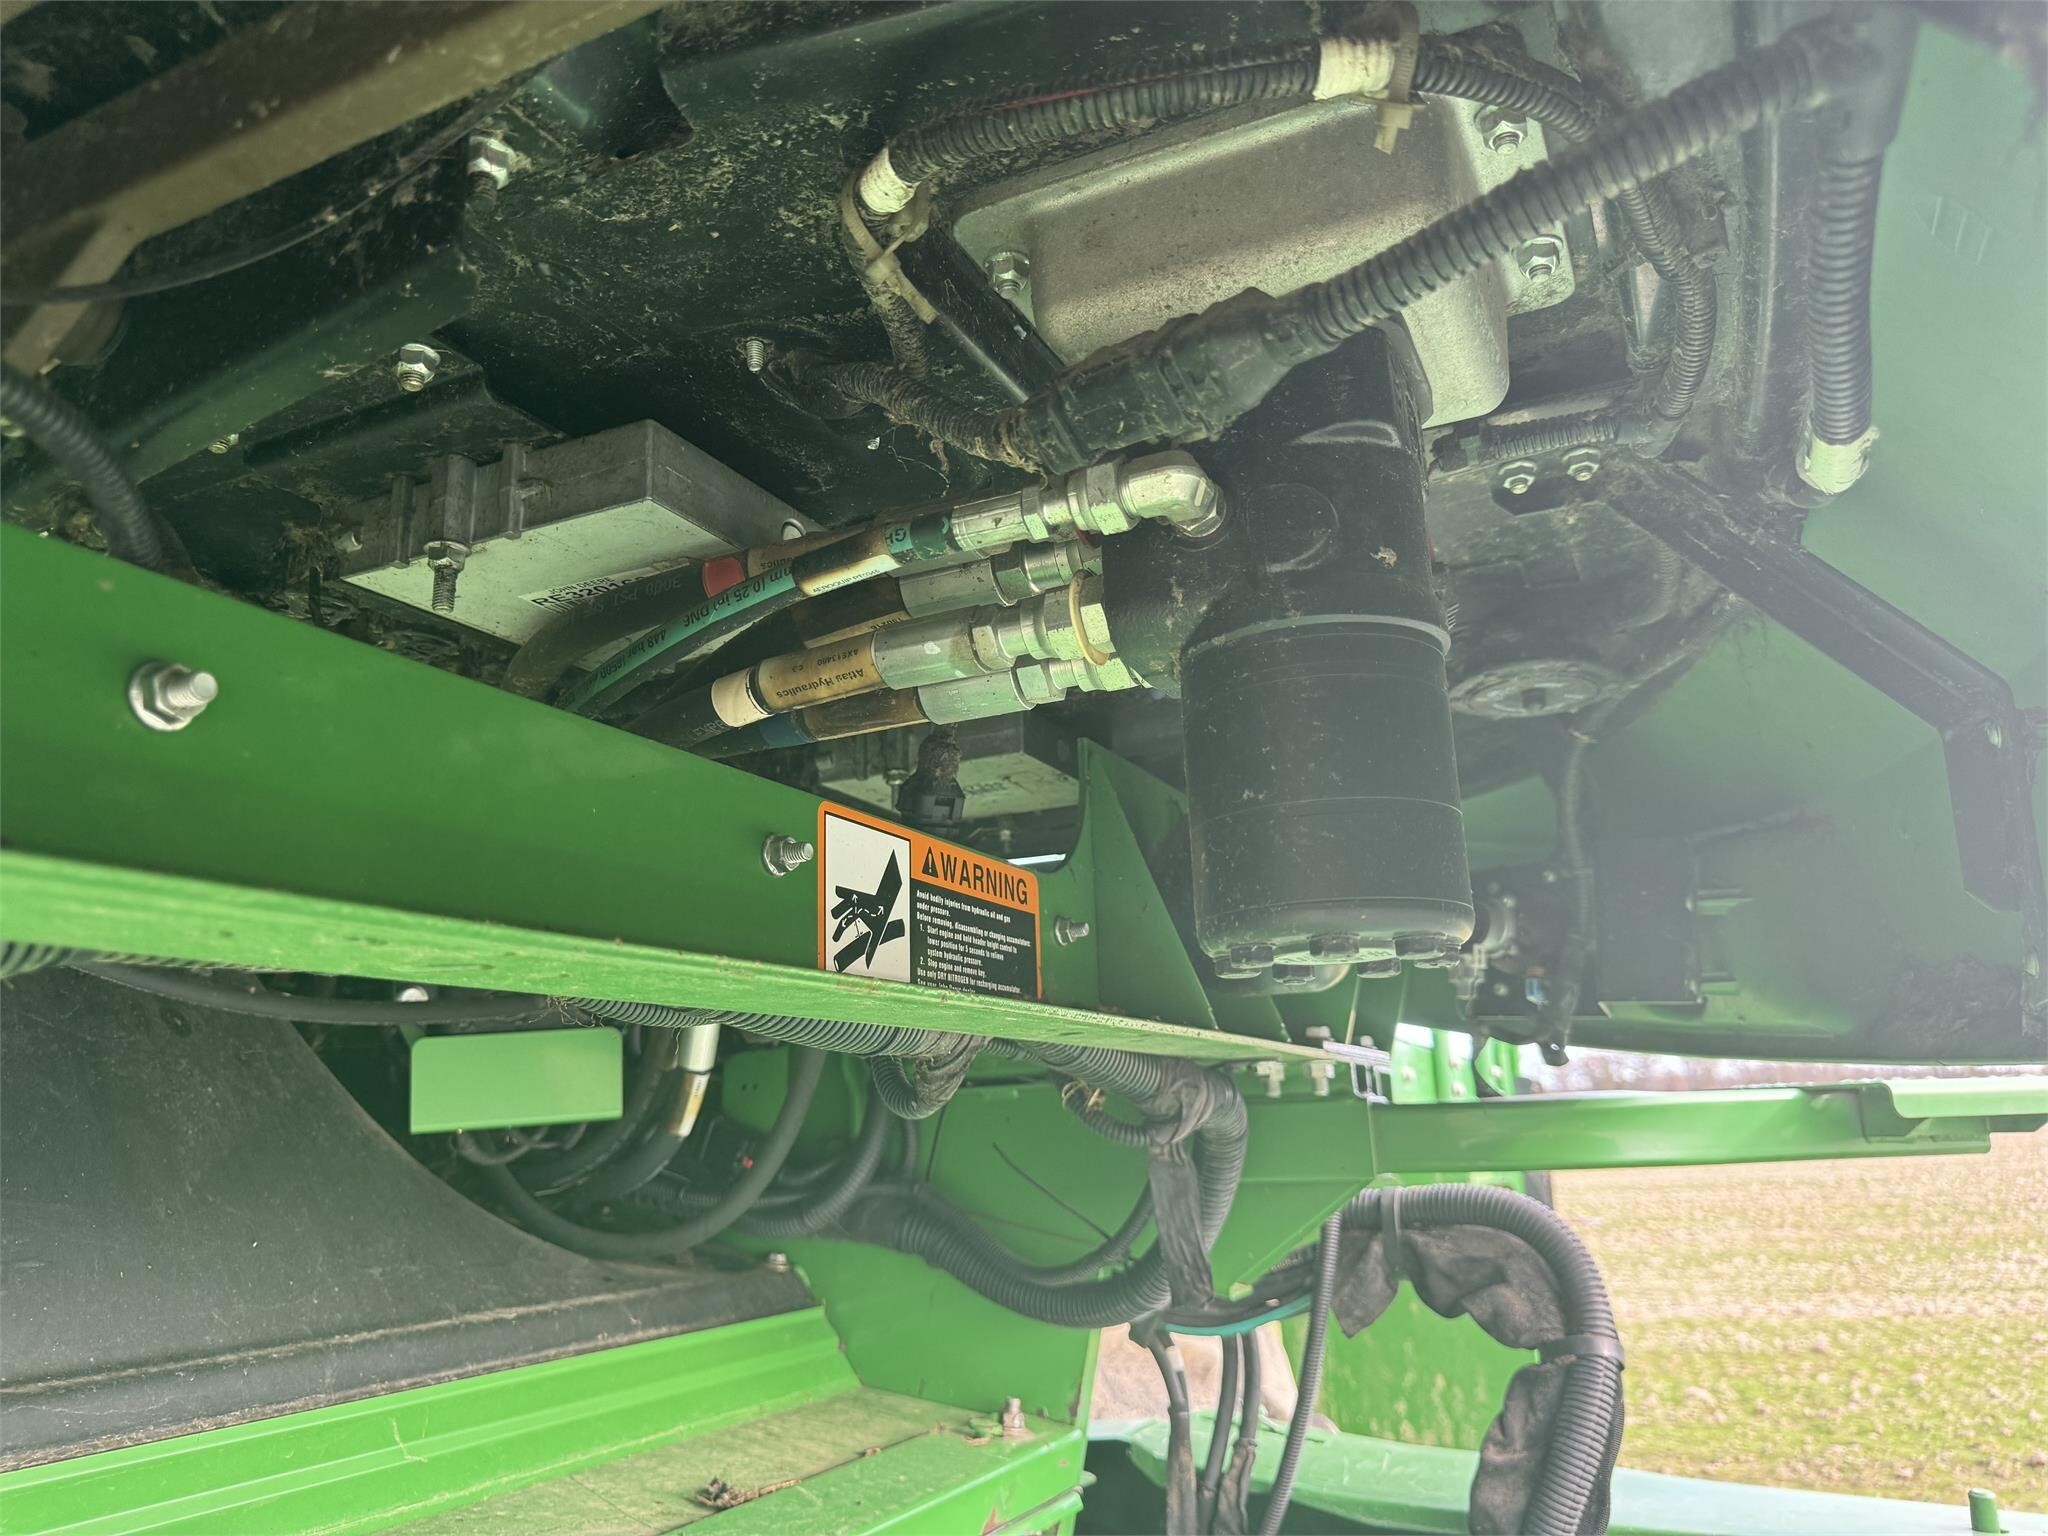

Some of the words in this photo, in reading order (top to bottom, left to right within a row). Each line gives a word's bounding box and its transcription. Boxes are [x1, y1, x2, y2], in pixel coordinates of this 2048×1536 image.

[835, 668, 865, 683] Atlas
[776, 677, 835, 698] Hydraulics
[940, 852, 1028, 905] WARNING
[917, 890, 929, 900] Avoid
[930, 893, 943, 905] bodily
[945, 897, 960, 909] injuries
[961, 902, 971, 912] from
[971, 905, 989, 917] hydraulic
[917, 902, 929, 911] under
[931, 905, 950, 917] pressure.
[917, 911, 931, 922] Before
[955, 921, 983, 937] disassembling
[927, 925, 938, 935] Start
[939, 929, 953, 939] engine
[954, 932, 962, 941] and
[963, 933, 971, 943] hold
[972, 936, 986, 946] header
[987, 939, 999, 950] height
[1000, 943, 1012, 953] control
[927, 936, 939, 946] lower
[941, 940, 957, 951] position
[969, 946, 985, 957] seconds
[920, 955, 925, 965] 2.
[927, 957, 937, 969] Stop
[939, 961, 953, 972] engine
[962, 966, 977, 976] remove
[927, 948, 942, 958] system
[944, 951, 963, 962] hydraulic
[917, 967, 926, 977] Use
[927, 970, 936, 980] only
[938, 971, 947, 980] DRY
[948, 973, 969, 984] NITROGEN
